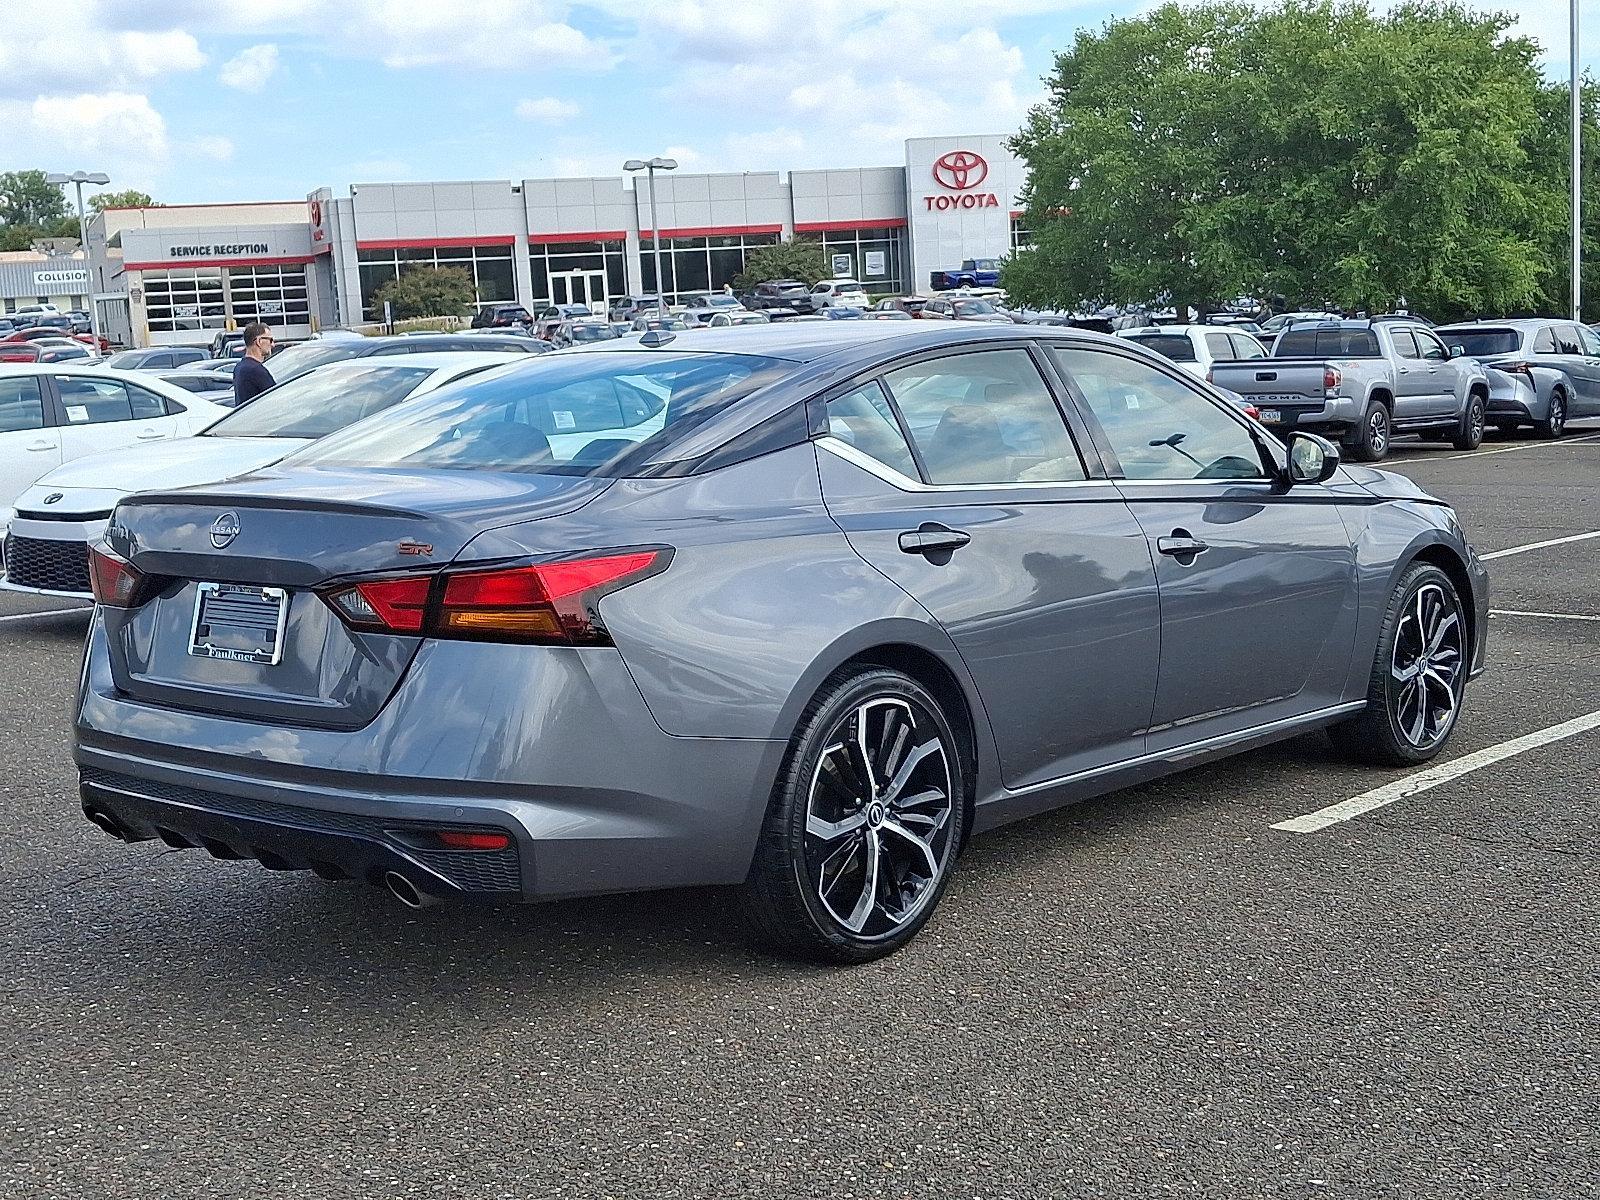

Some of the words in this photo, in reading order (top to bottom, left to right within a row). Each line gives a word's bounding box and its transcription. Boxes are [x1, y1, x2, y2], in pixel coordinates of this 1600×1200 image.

[923, 193, 999, 211] TOYOTA
[170, 246, 212, 256] SERVICE
[213, 244, 269, 255] RECEPTION
[398, 541, 434, 557] SR
[208, 648, 256, 661] Faulkner
